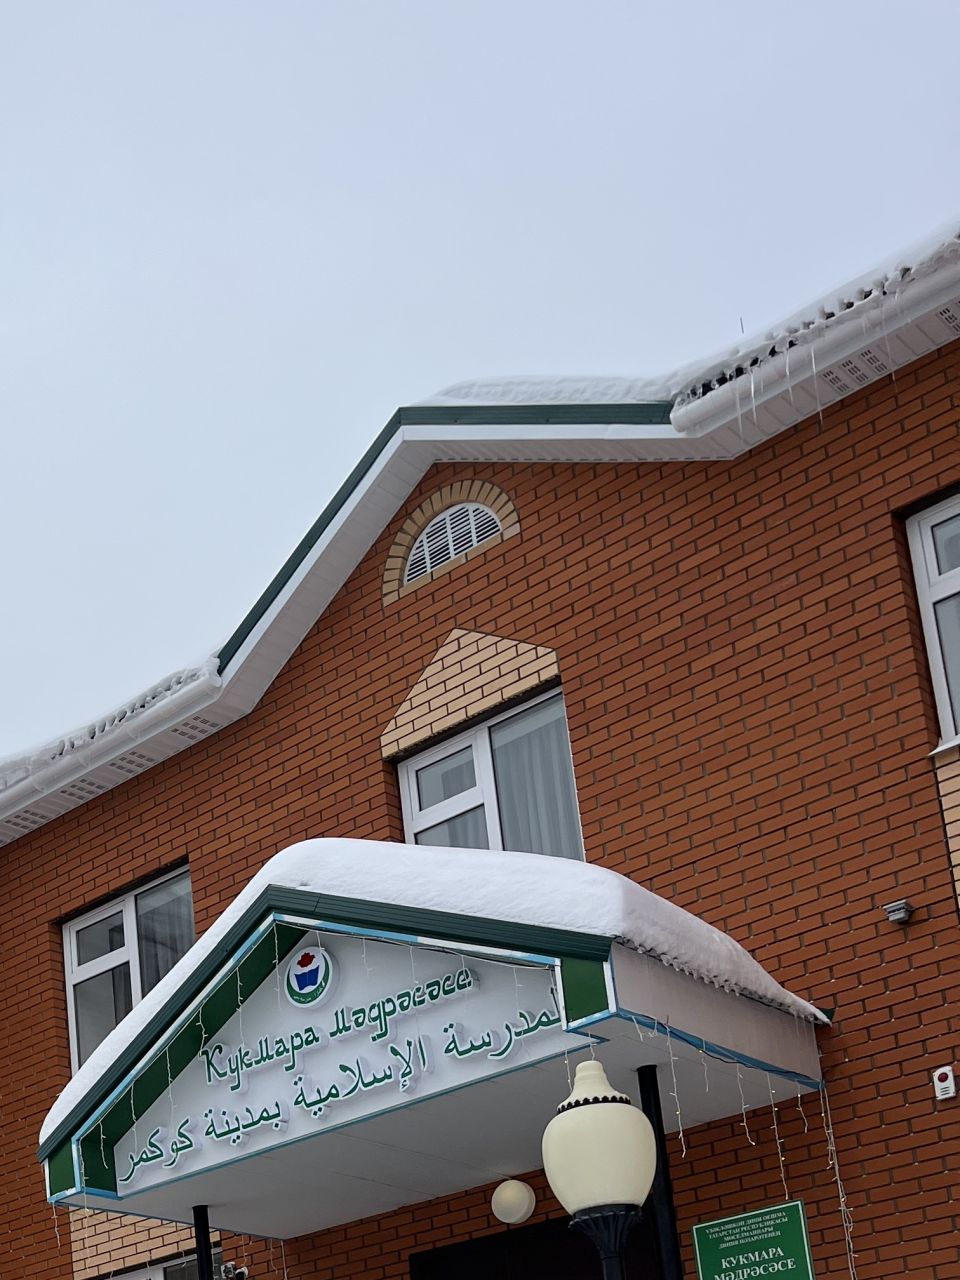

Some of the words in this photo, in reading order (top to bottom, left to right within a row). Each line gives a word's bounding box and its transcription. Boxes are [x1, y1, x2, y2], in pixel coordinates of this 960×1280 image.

[200, 1026, 320, 1092] Кукмара
[204, 1100, 281, 1144] بمدينة
[721, 1246, 785, 1269] КУКМАРА
